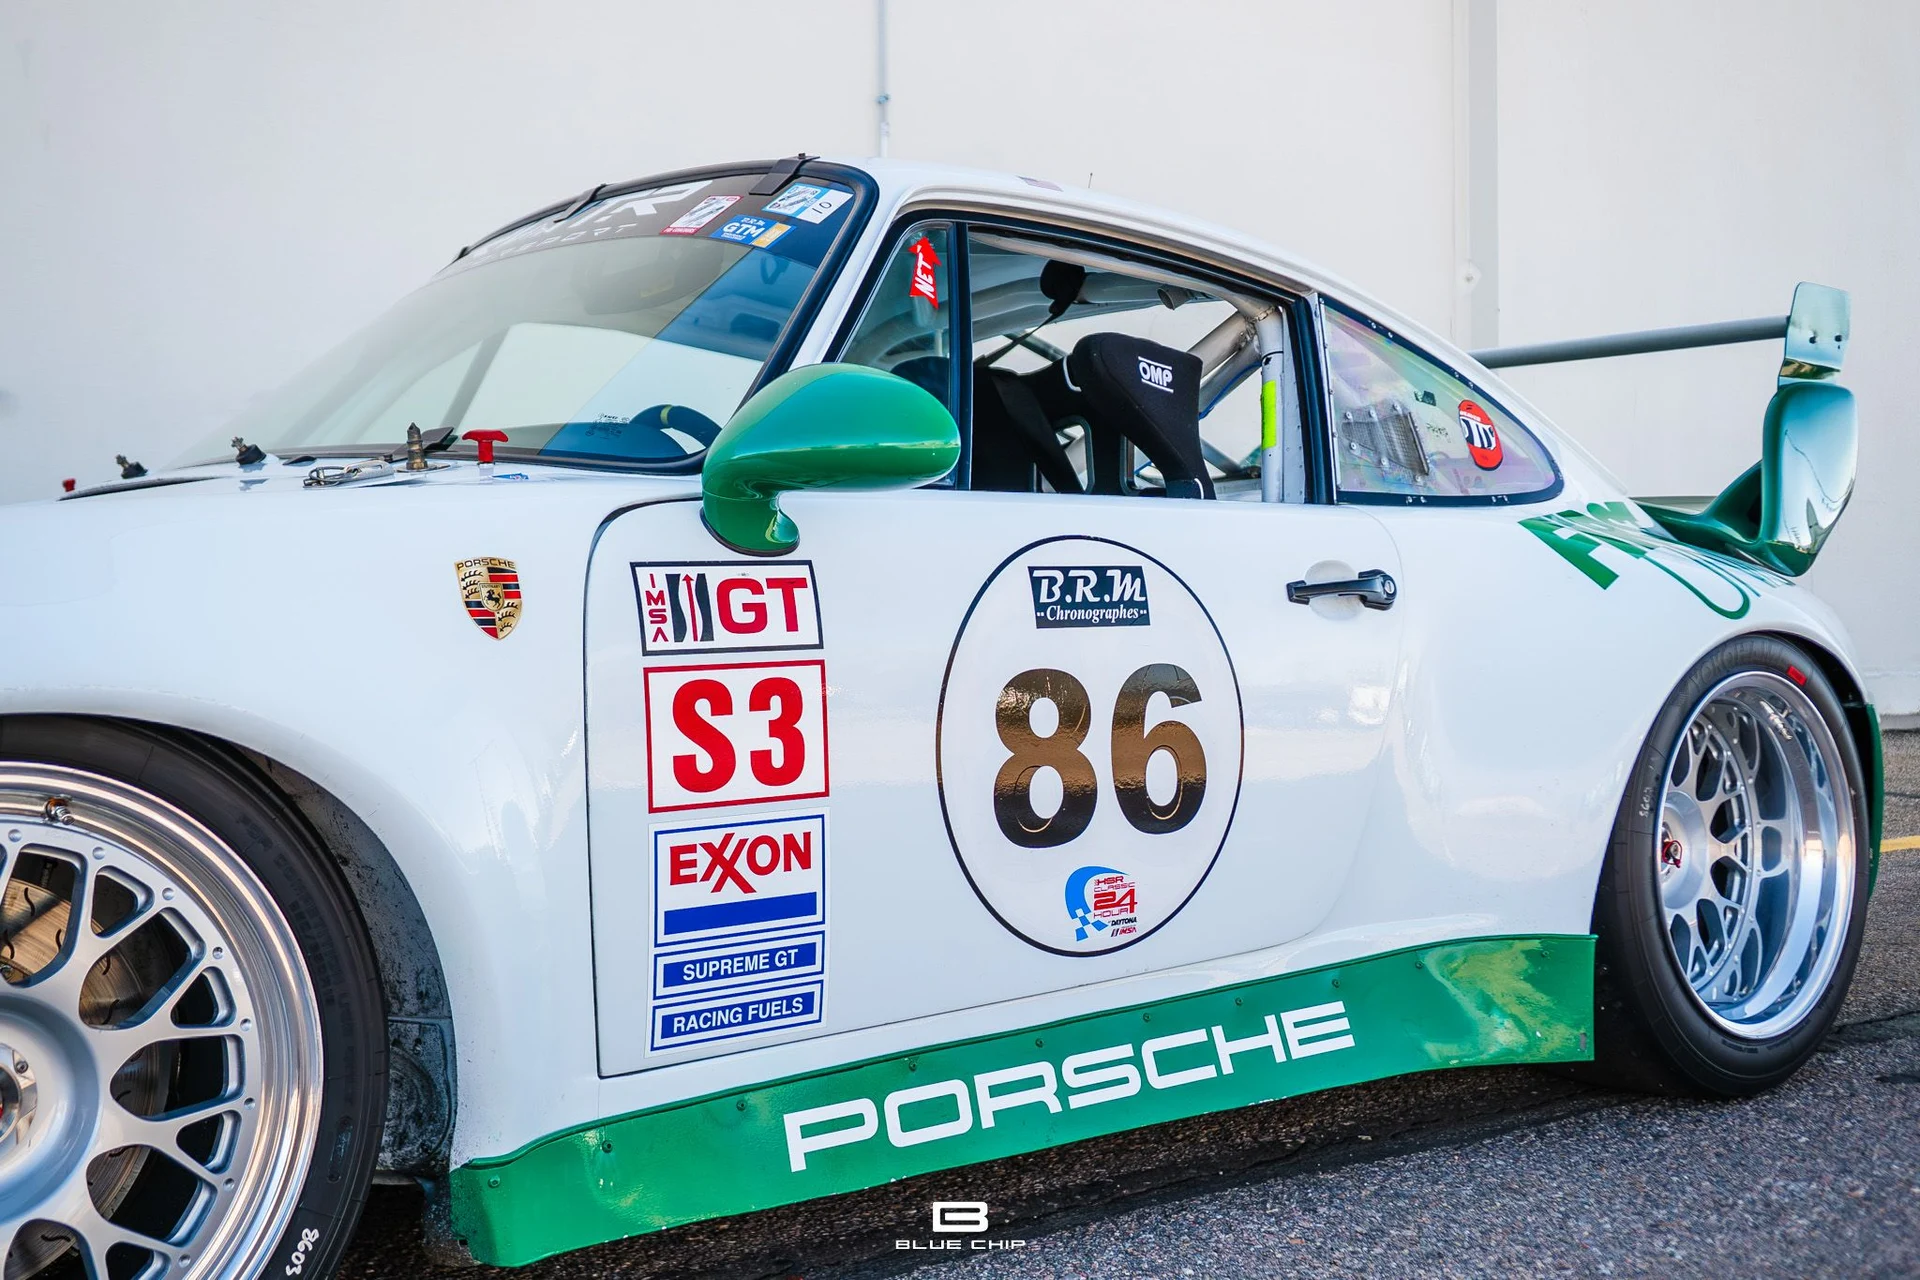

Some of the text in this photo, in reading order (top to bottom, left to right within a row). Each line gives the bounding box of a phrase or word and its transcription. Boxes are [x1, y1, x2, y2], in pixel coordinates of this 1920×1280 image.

[722, 222, 765, 238] GTM
[914, 250, 936, 299] NET
[1139, 361, 1174, 387] OMP
[456, 558, 516, 570] PORSCHE
[645, 573, 669, 642] IMSA
[717, 577, 808, 634] GT
[1046, 604, 1139, 624] Chronographes
[672, 677, 806, 793] S3
[993, 662, 1207, 849] 86
[670, 831, 811, 894] EXXON
[1094, 888, 1138, 914] 24
[1094, 907, 1129, 919] HOUR
[1111, 917, 1137, 926] DAYTONA
[682, 949, 799, 981] SUPREME GT
[673, 997, 804, 1033] RACING FUELS
[783, 1000, 1355, 1173] PORSCHE
